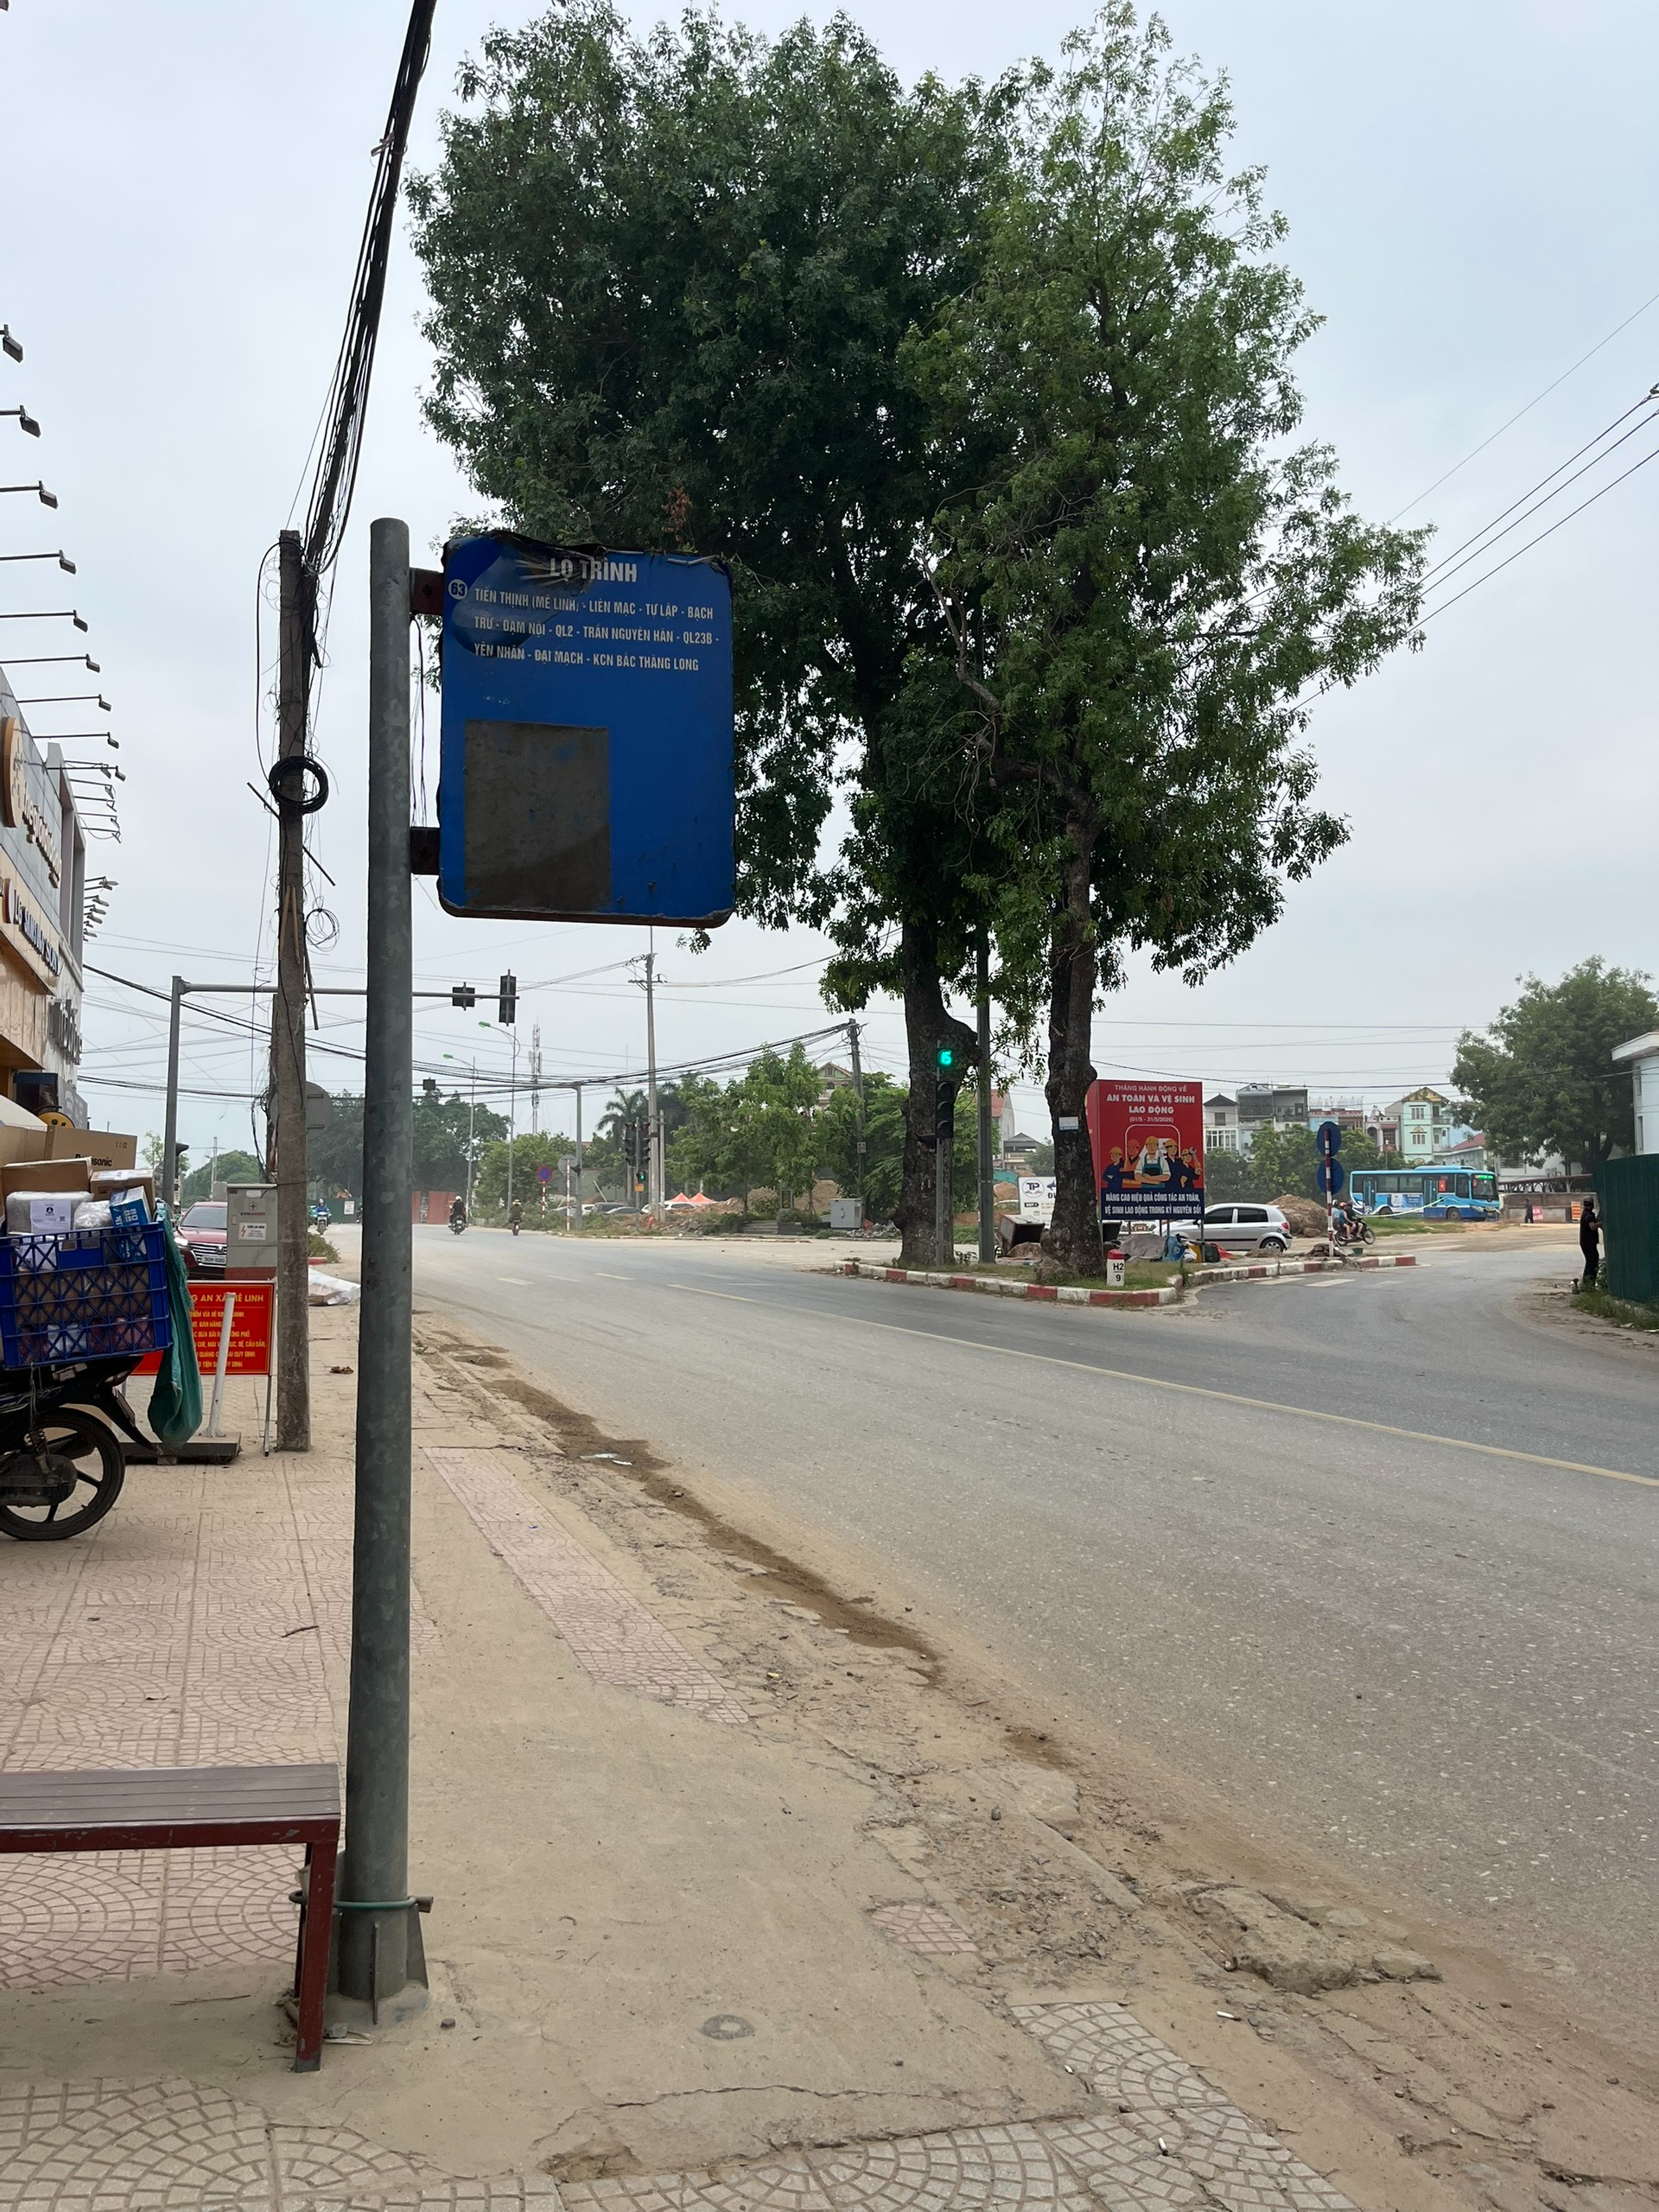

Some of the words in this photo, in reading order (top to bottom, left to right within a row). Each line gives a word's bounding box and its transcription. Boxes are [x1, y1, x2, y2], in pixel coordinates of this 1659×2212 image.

[450, 582, 466, 596] 63
[499, 591, 529, 608] THỊNH
[588, 598, 611, 613] LIÊN
[613, 601, 636, 617] MẠC
[645, 603, 658, 619] TỰ
[659, 602, 678, 620] LẬP
[687, 606, 713, 621] BẠCH
[555, 624, 574, 638] QL2
[612, 626, 651, 642] NGUYÊN
[683, 631, 713, 645] QL23B
[497, 645, 525, 660] NHÂN
[534, 649, 552, 664] ĐẠI
[554, 651, 584, 667] MẠCH
[593, 652, 613, 666] KCN
[673, 658, 699, 671] LONG
[1122, 1093, 1146, 1103] TOÀN
[1147, 1094, 1160, 1103] VÀ
[1161, 1094, 1173, 1104] VỆ
[1128, 1105, 1146, 1114] LAO
[1147, 1105, 1174, 1116] ĐỘNG
[1026, 1182, 1040, 1191] TP
[1112, 1262, 1124, 1271] H2
[1116, 1274, 1122, 1282] 9
